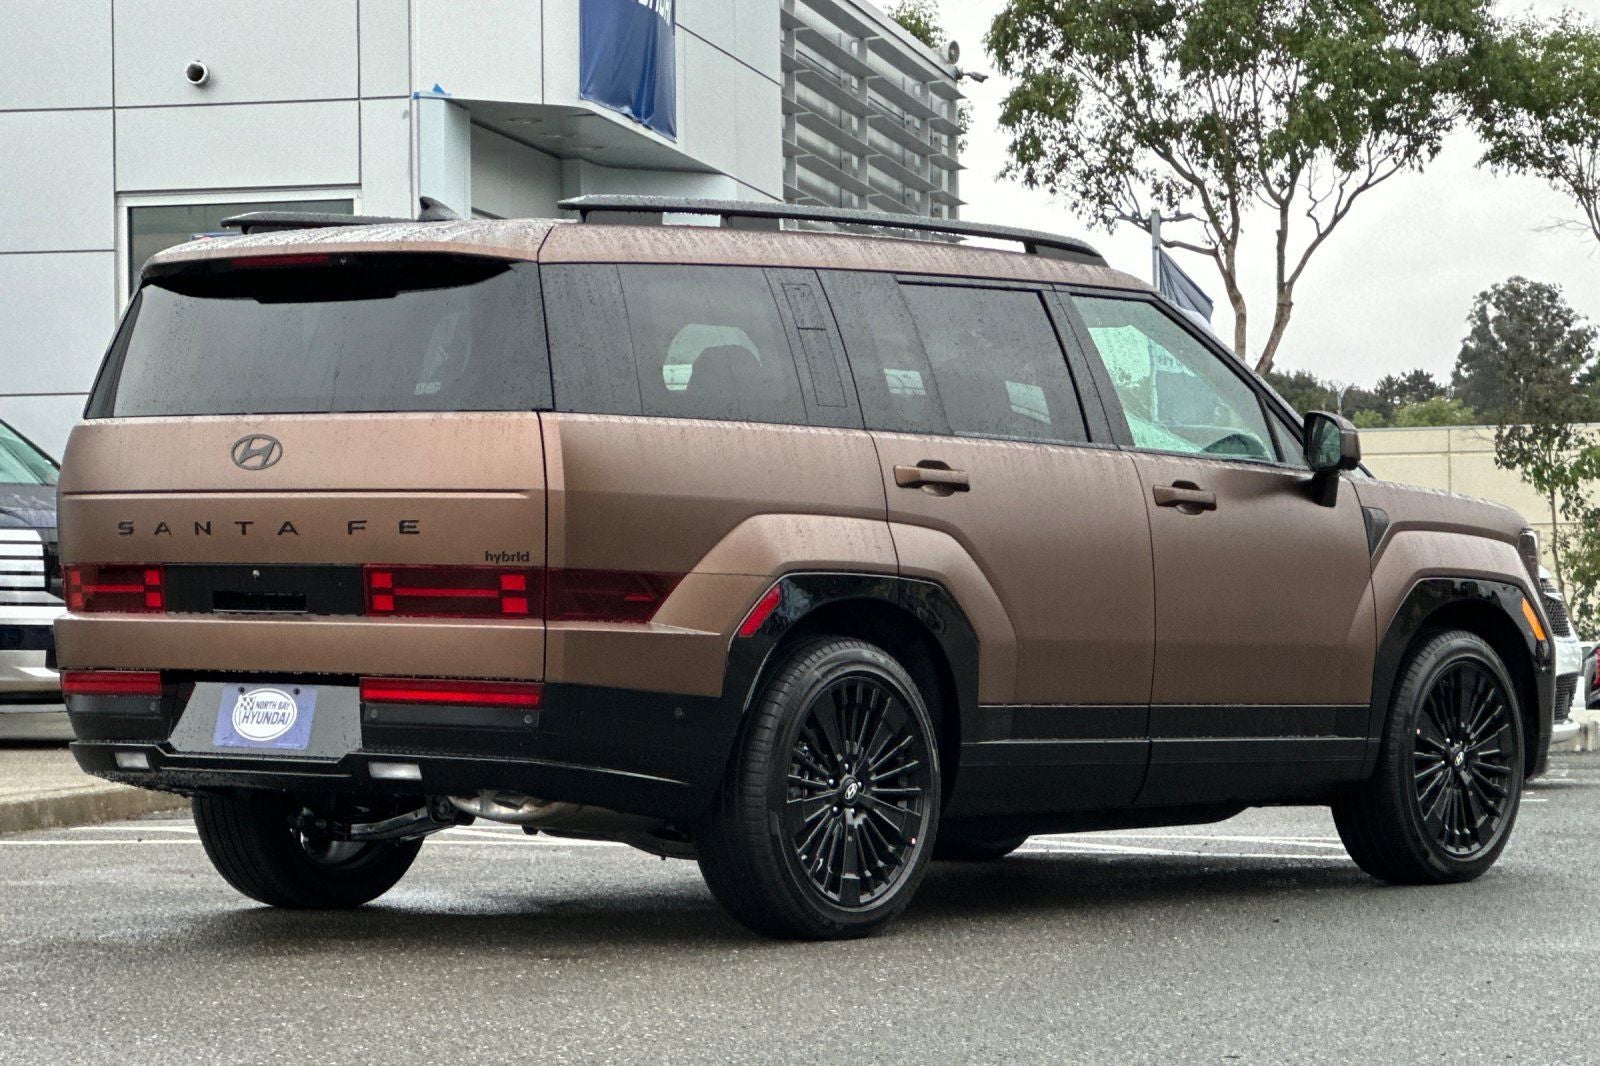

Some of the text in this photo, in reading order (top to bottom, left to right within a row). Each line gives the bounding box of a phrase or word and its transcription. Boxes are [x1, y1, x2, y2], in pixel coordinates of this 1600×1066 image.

[117, 519, 420, 536] SANTA FE
[485, 550, 530, 564] hybrid
[255, 700, 291, 710] NORTH BAY
[241, 710, 291, 725] HYUNDAI
